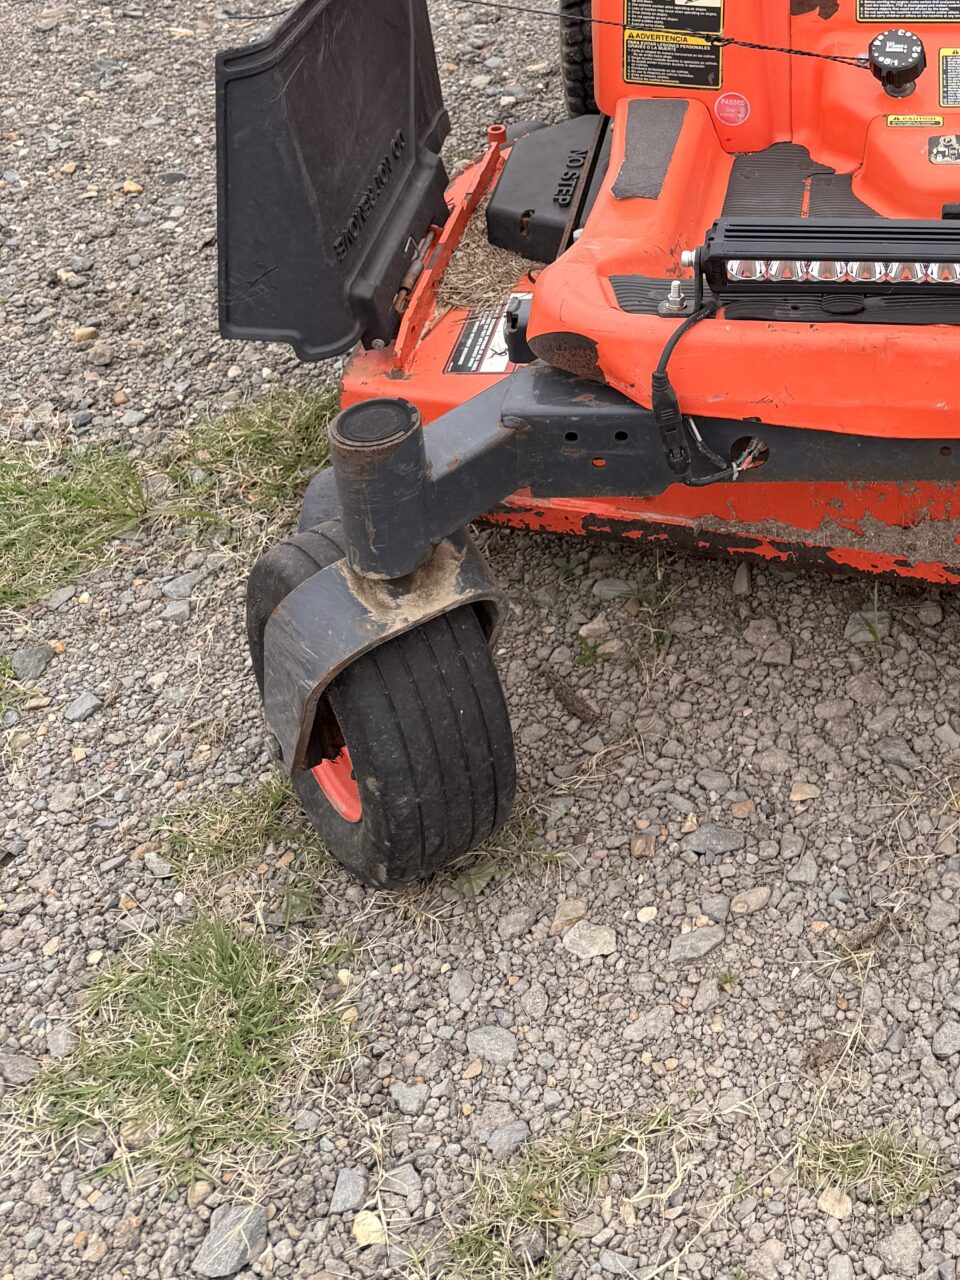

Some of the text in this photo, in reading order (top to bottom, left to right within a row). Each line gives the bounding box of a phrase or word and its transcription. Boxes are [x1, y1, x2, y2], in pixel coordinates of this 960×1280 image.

[635, 32, 688, 43] ADVERTENCIA
[552, 149, 589, 208] NO STEP
